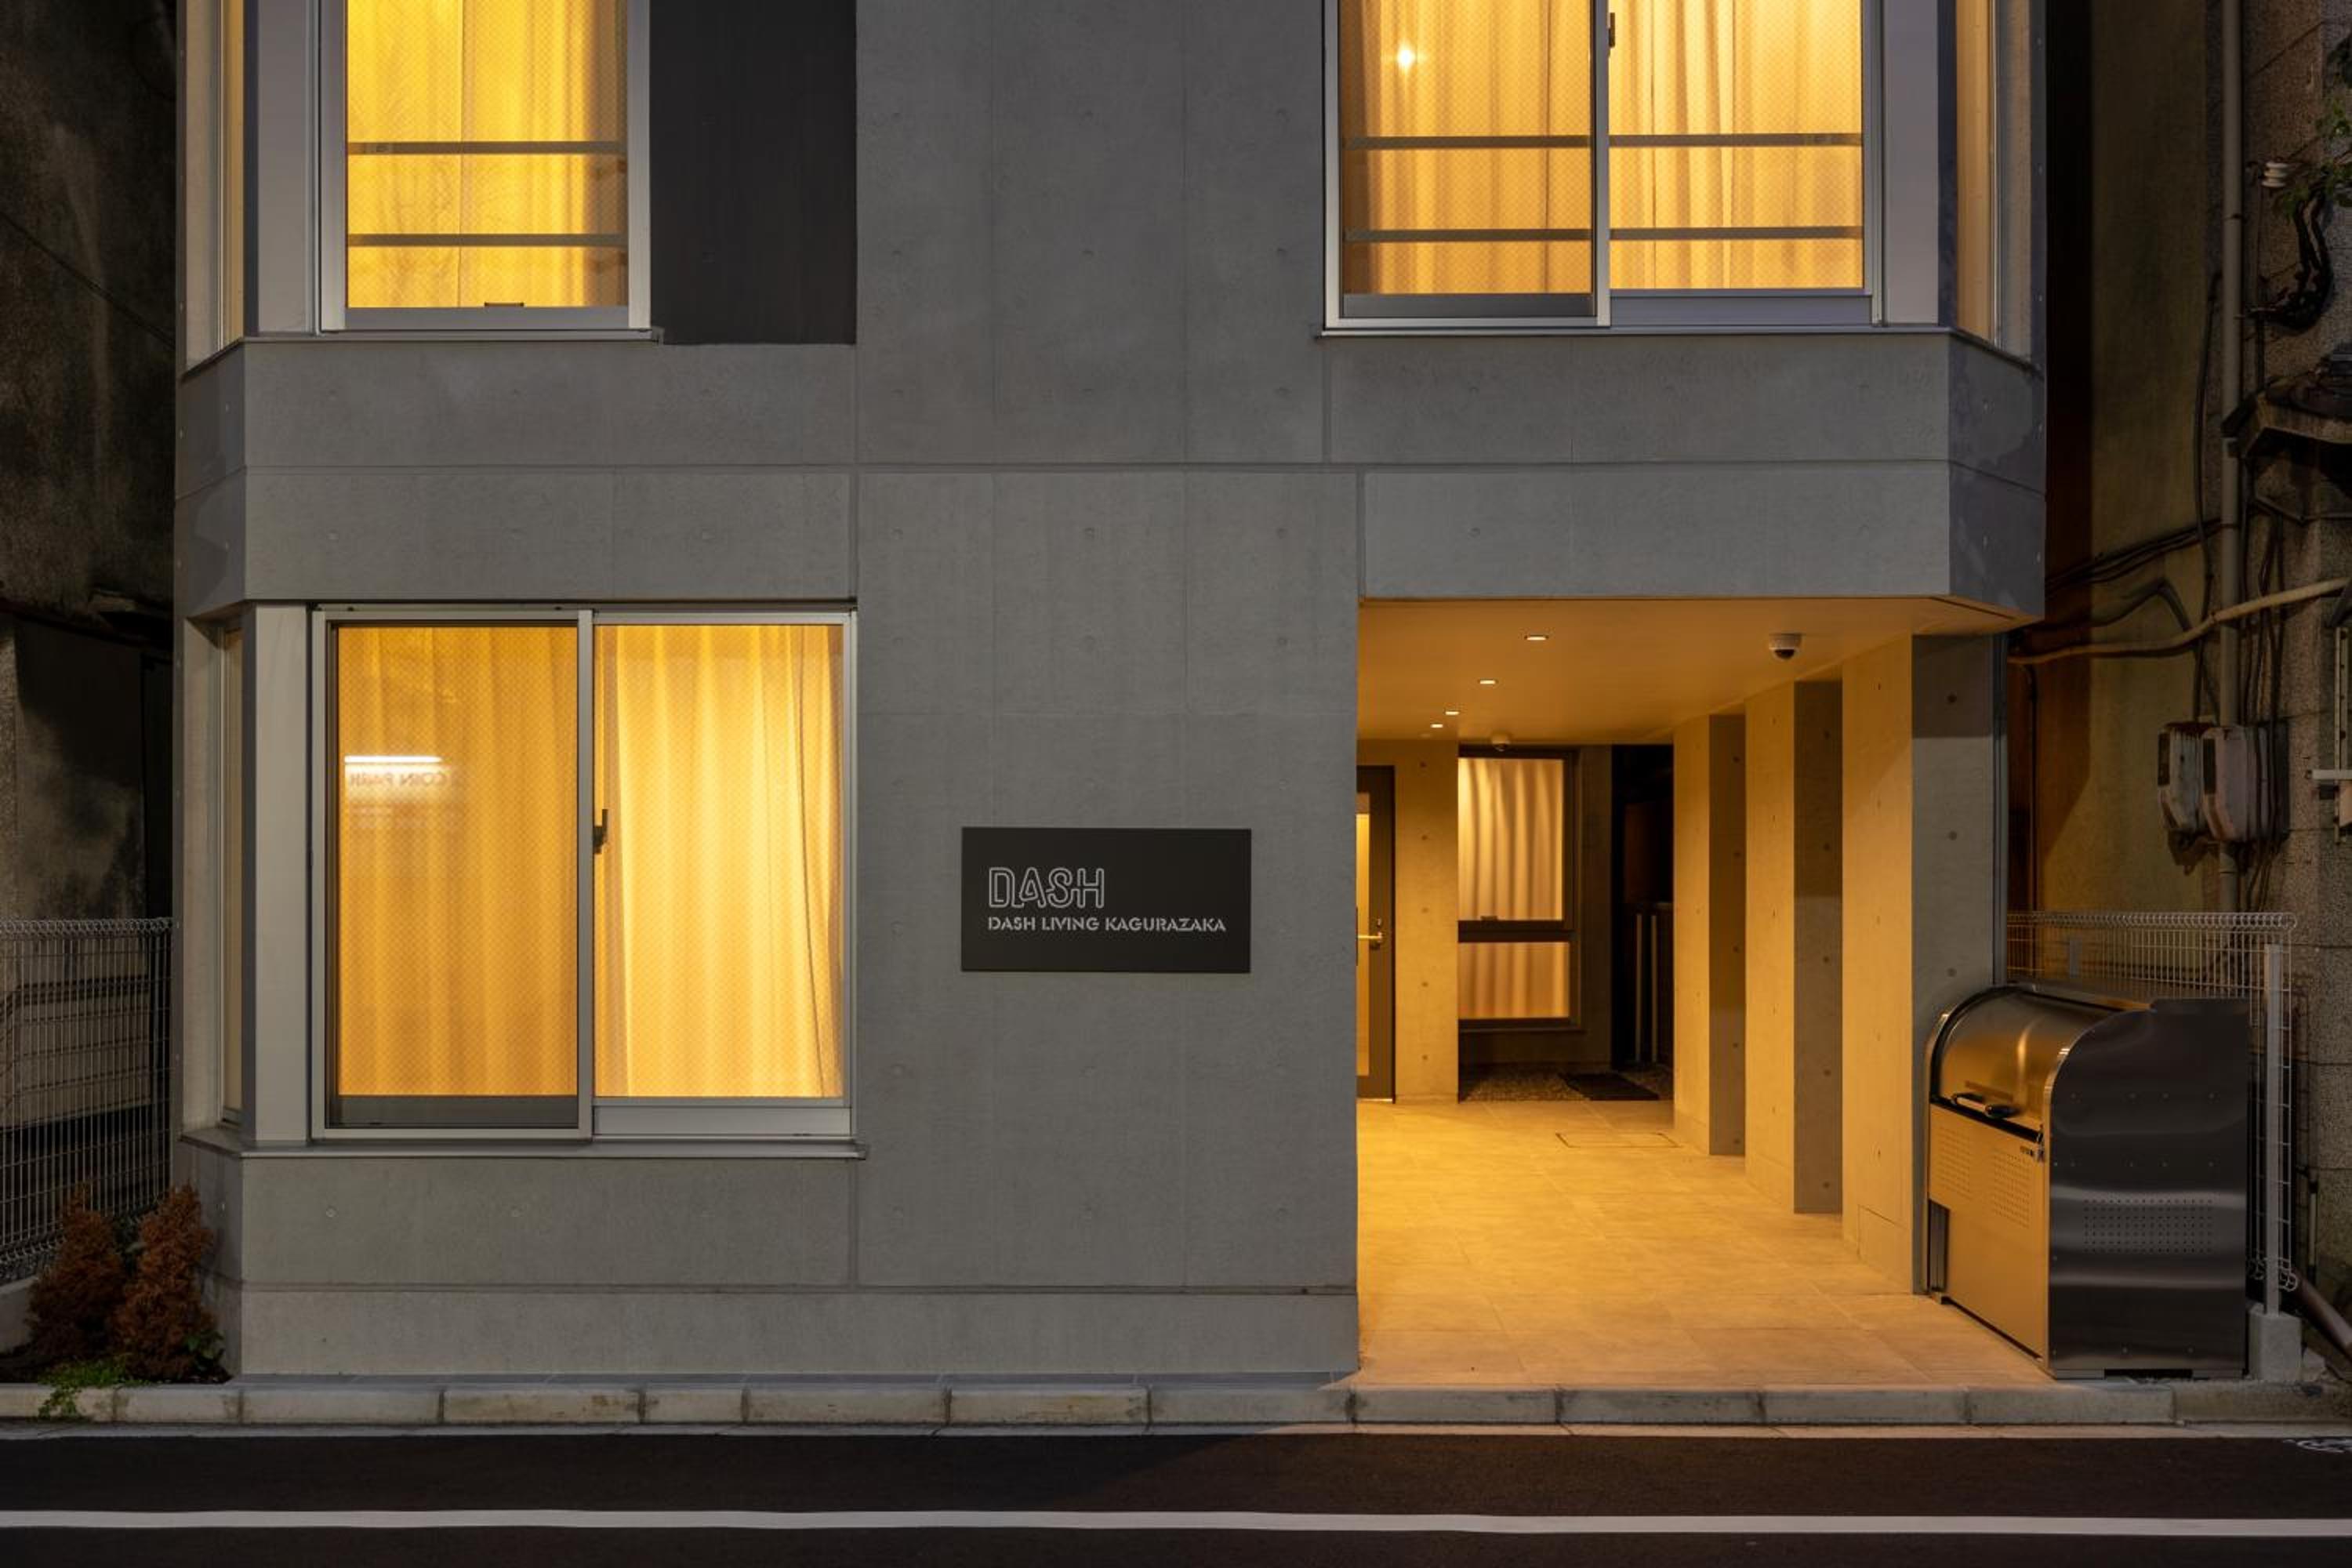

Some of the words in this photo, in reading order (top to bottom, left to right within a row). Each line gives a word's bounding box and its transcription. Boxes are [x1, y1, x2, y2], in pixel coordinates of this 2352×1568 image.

[988, 866, 1105, 909] DASH
[988, 916, 1036, 931] DASH
[1041, 916, 1100, 931] LIVING
[1105, 916, 1226, 932] KAGURAZAKA
